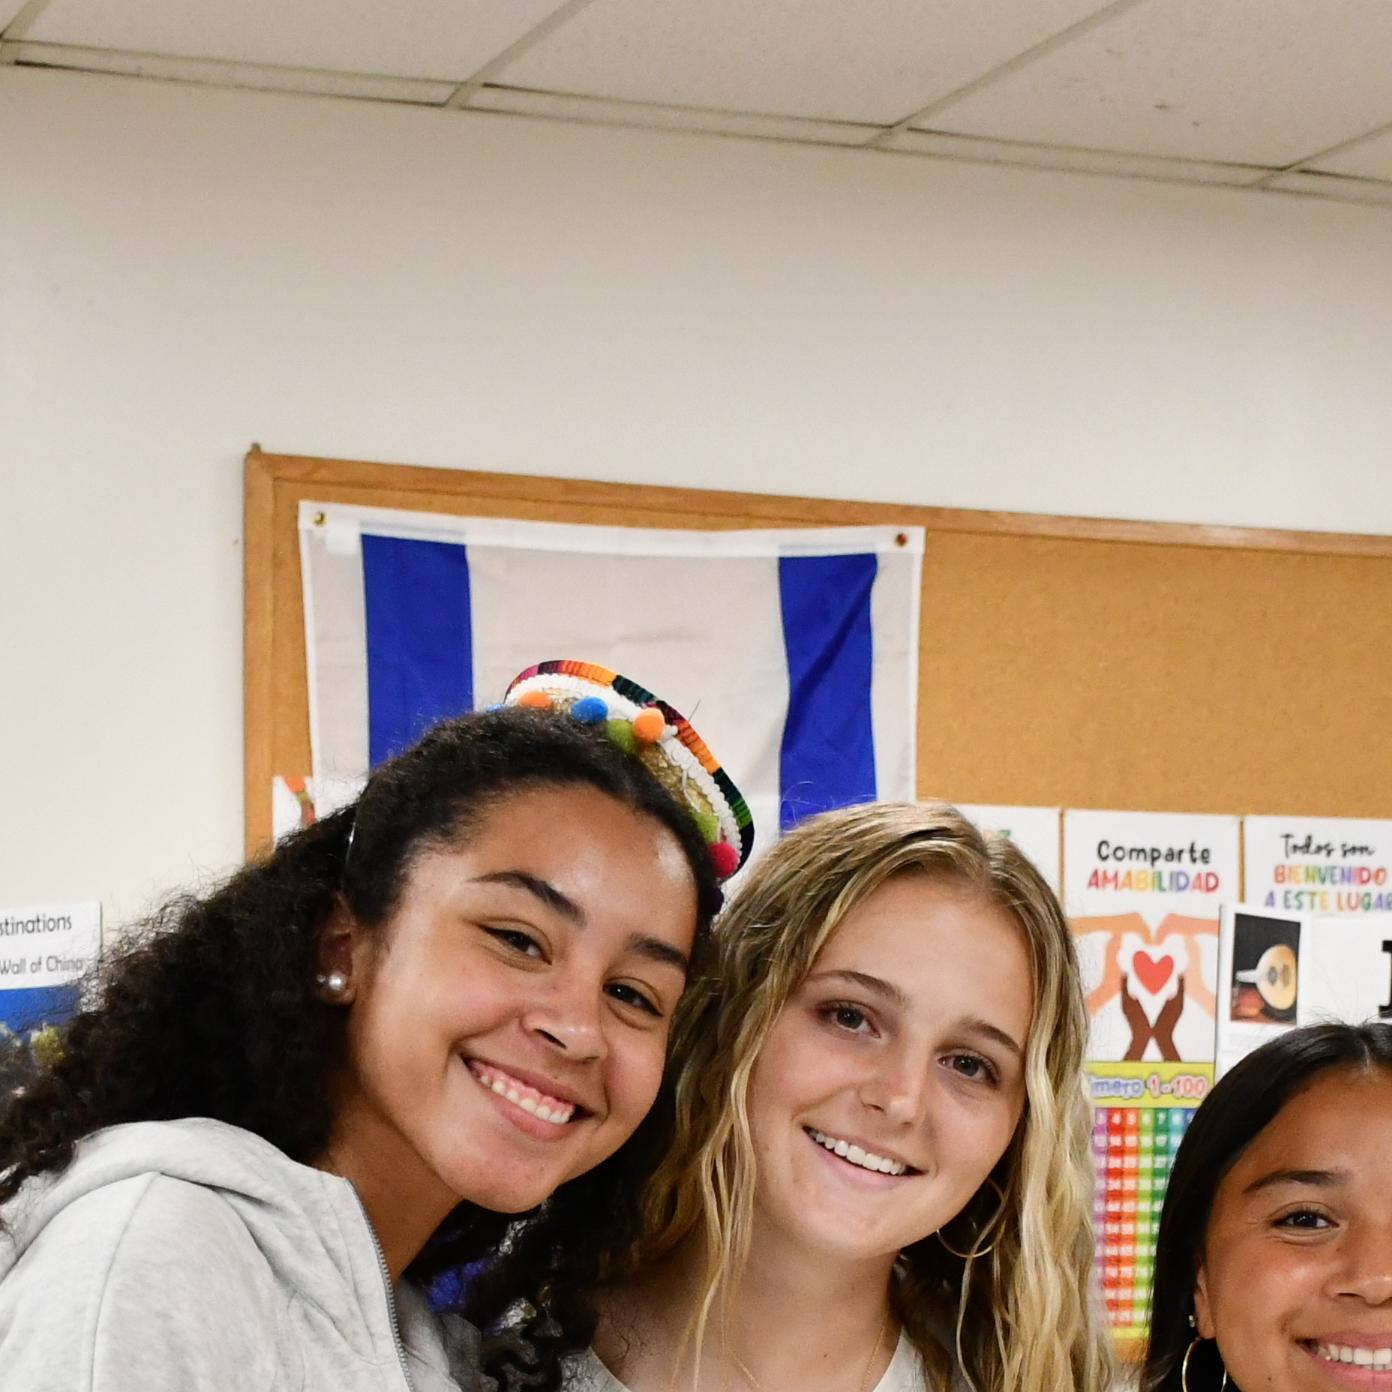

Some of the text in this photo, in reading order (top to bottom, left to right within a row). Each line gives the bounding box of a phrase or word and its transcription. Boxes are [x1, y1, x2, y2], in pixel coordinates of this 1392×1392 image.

[1096, 840, 1211, 867] Comparte
[1280, 833, 1375, 858] Todos son
[1087, 869, 1220, 893] AMABILIDAD
[1265, 890, 1276, 906] A
[1283, 890, 1328, 910] ESTE
[30, 958, 42, 973] of
